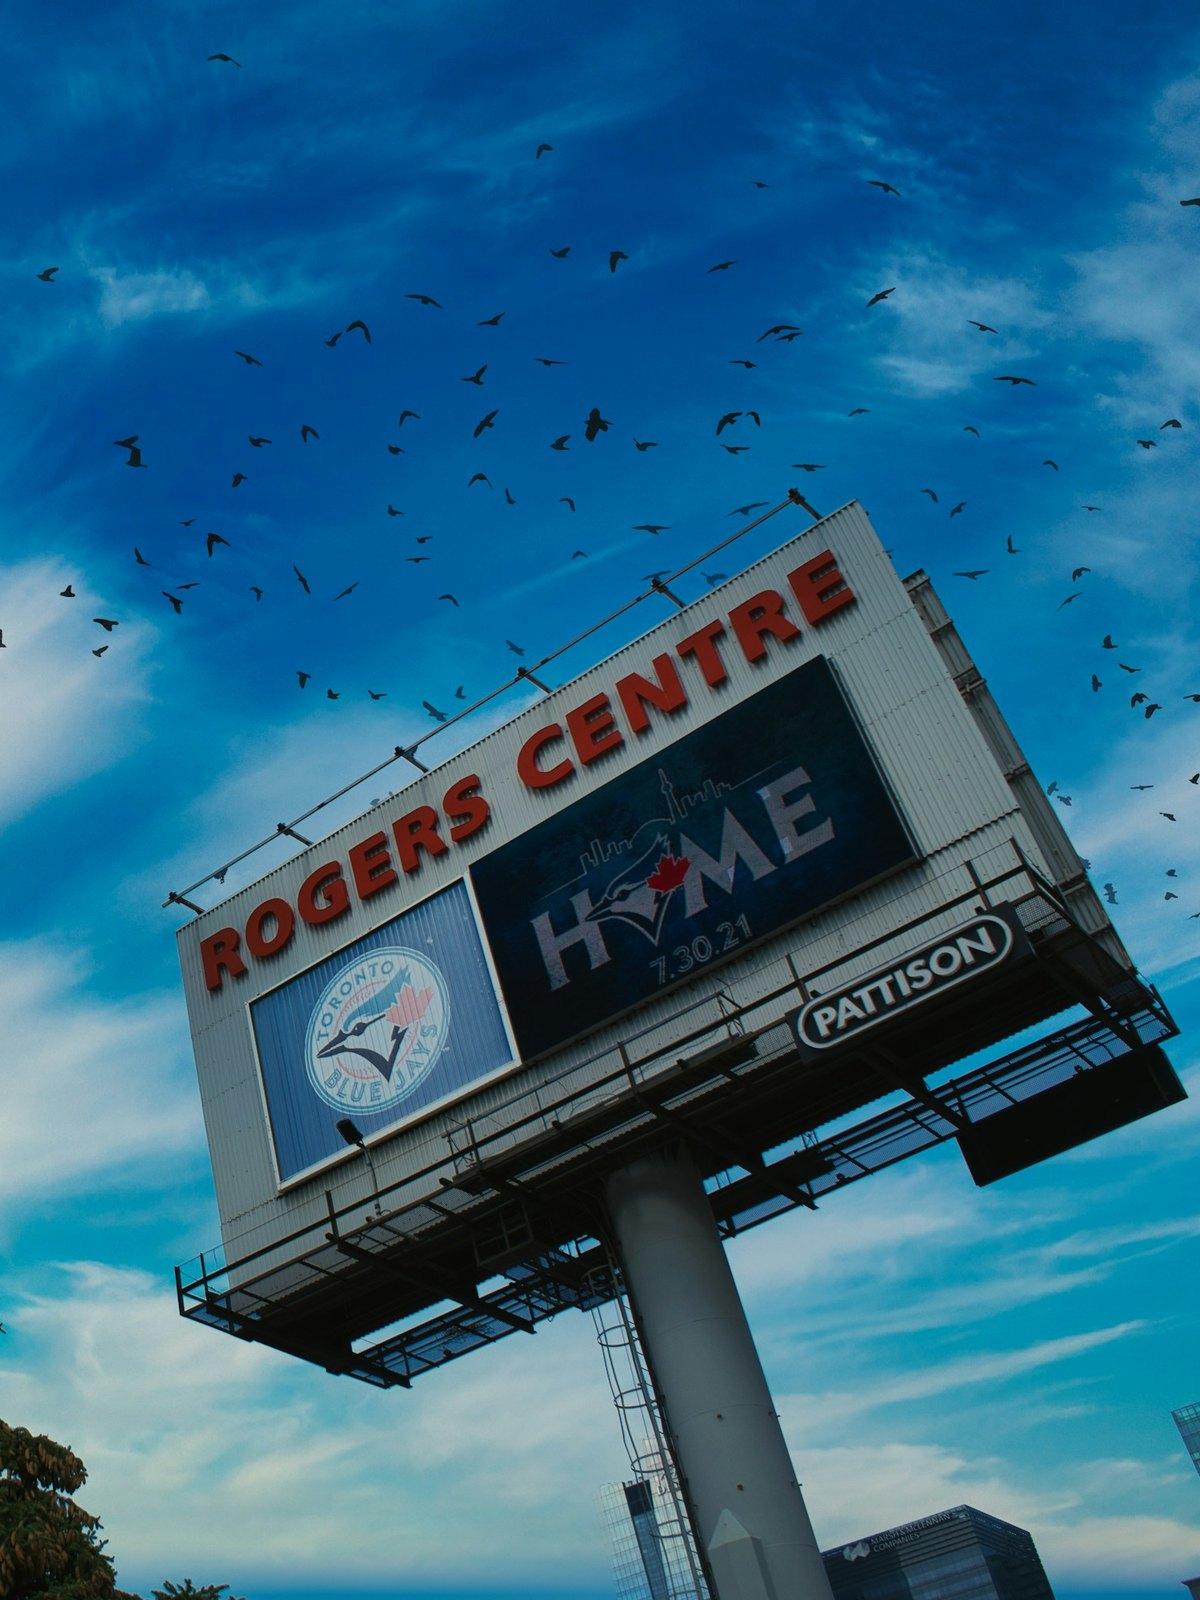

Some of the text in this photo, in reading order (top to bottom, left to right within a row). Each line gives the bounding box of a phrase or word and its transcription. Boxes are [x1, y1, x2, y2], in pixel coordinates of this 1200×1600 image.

[200, 549, 856, 991] ROGERS CENTRE
[650, 913, 750, 985] 7.30.21
[812, 926, 997, 1038] PATTISON
[317, 960, 394, 1041] TORONTO
[324, 1023, 438, 1102] BLUE JAYS
